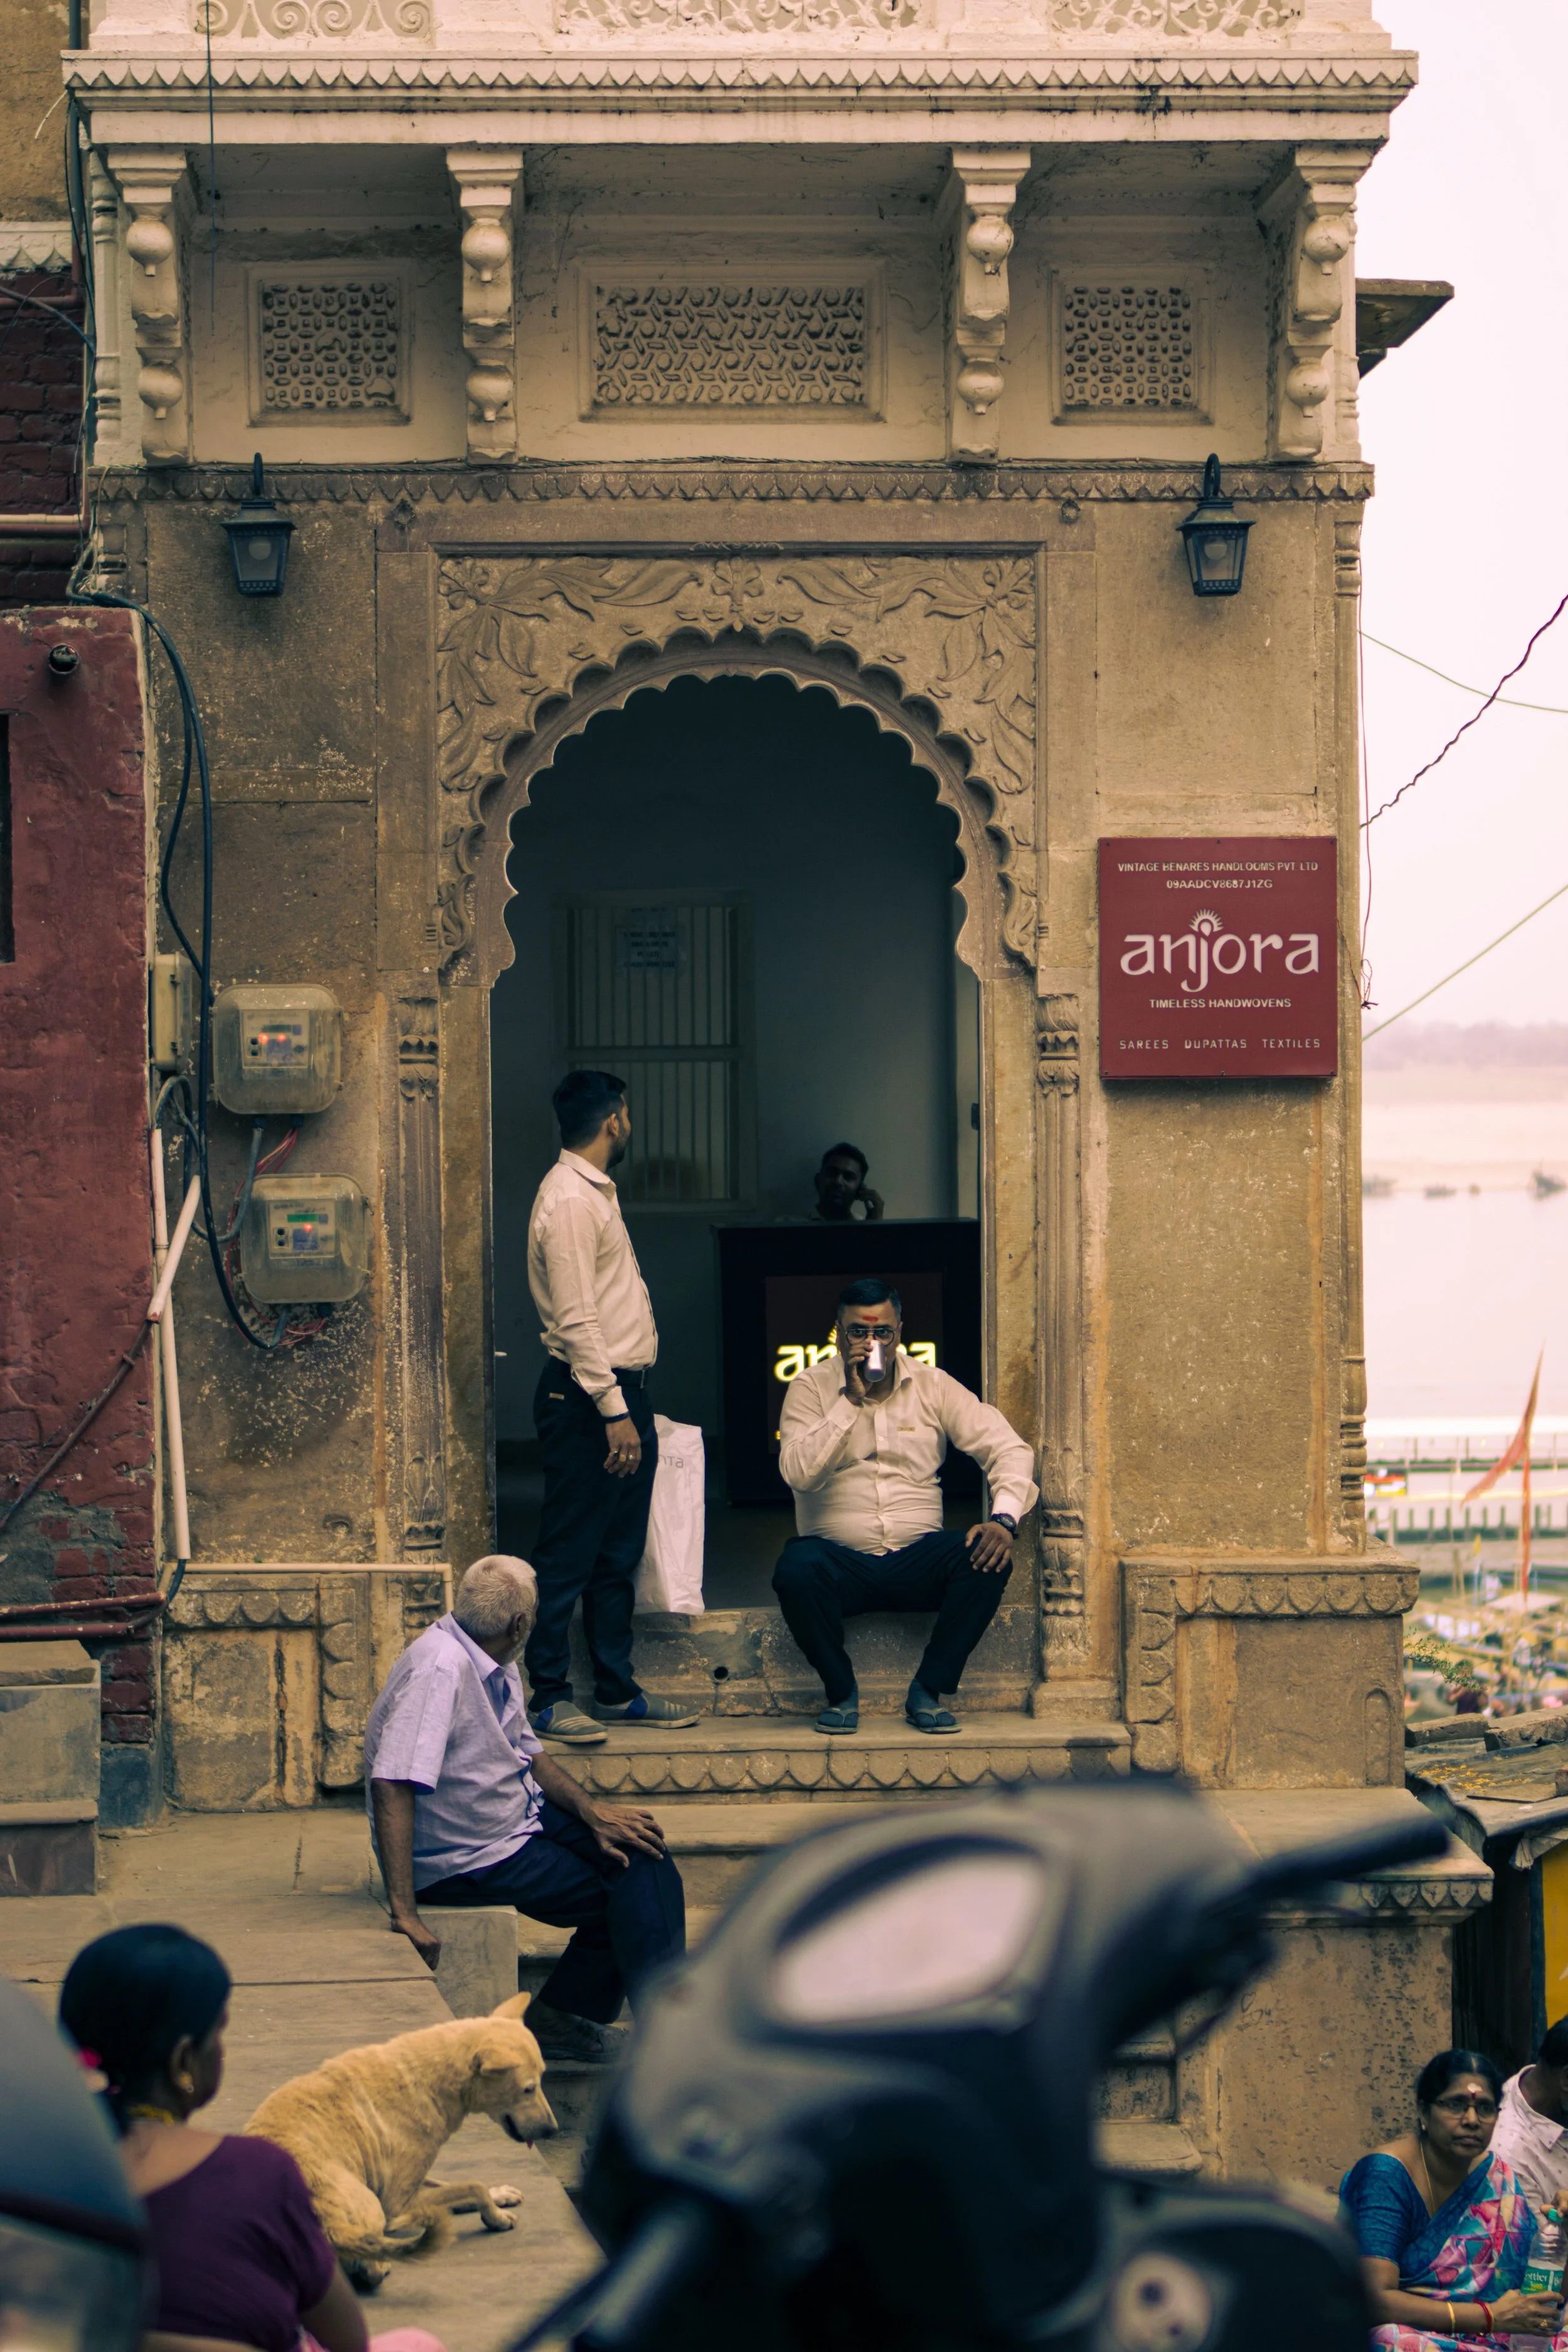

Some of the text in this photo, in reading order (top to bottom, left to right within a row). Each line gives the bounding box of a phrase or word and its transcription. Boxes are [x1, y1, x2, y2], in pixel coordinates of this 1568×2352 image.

[1118, 862, 1159, 872] VINTAGE
[1162, 862, 1209, 871] BENARES
[1212, 862, 1274, 871] HANDLOOMS
[1166, 879, 1273, 889] 09AADCV8687J1ZG
[1120, 919, 1319, 993] anjora
[1149, 998, 1291, 1008] TIMELESS HANDWOVENS
[1120, 1038, 1320, 1049] SAREES DUPATTAS TEXTILES
